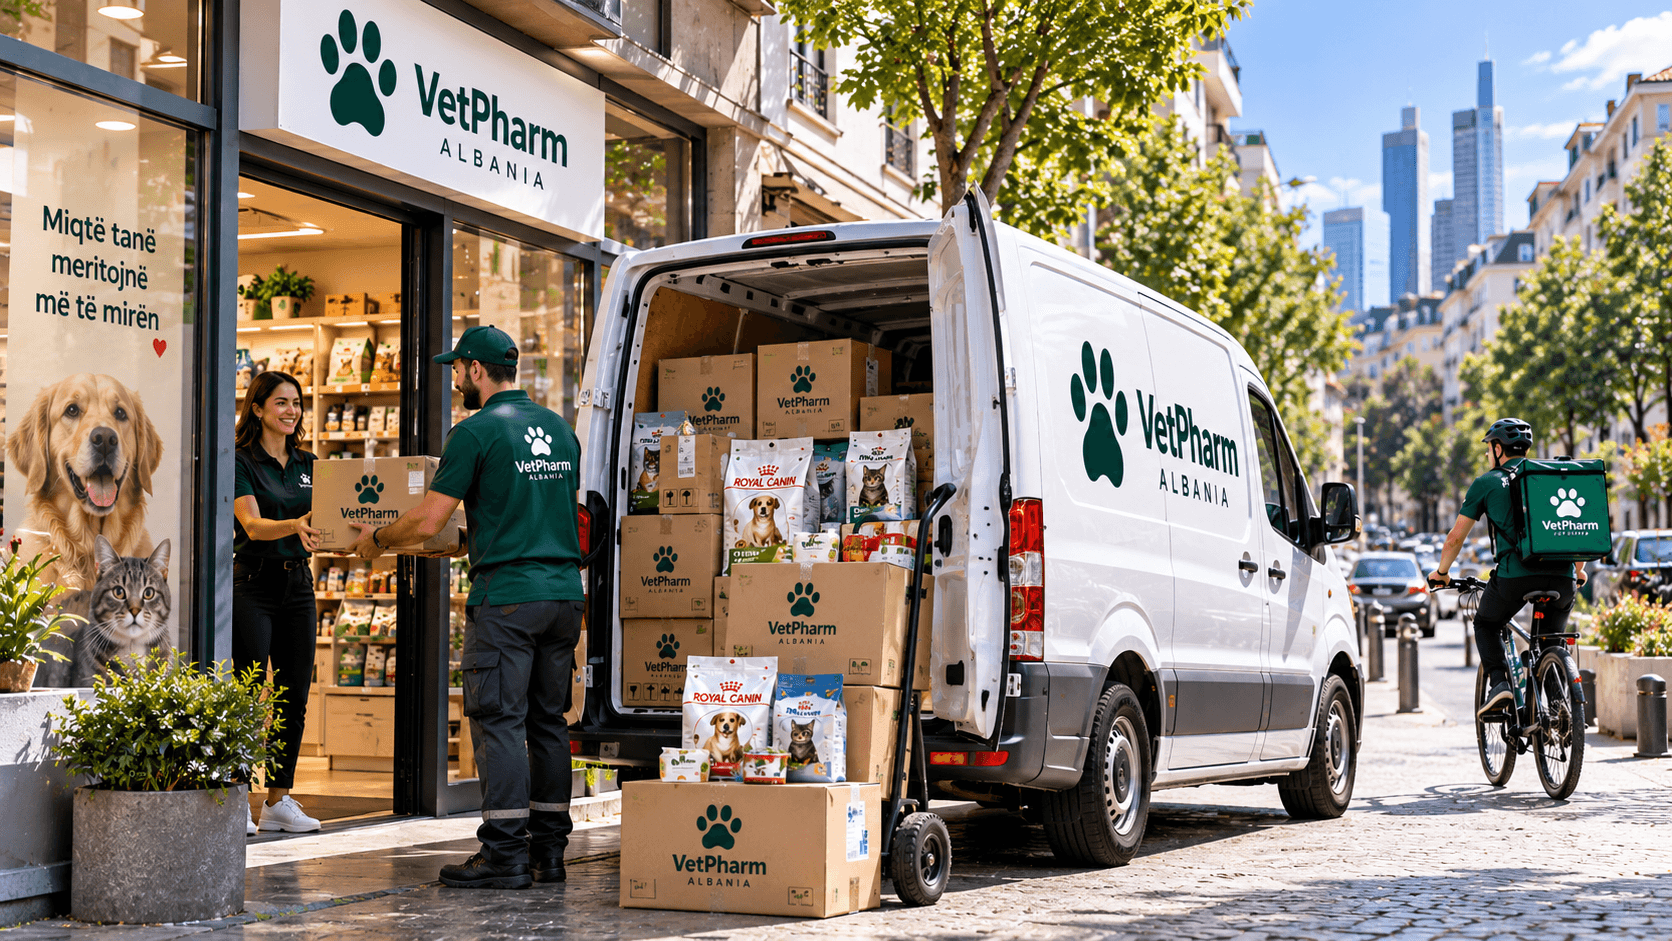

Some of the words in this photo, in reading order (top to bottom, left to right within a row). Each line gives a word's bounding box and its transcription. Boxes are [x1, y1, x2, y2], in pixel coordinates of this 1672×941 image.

[414, 62, 568, 168] VetPharm
[439, 138, 544, 190] ALBANIA
[42, 205, 106, 245] Miqtë
[111, 223, 157, 254] tanë
[51, 253, 149, 292] meritojnë
[35, 290, 70, 317] më
[75, 294, 97, 321] të
[103, 300, 160, 331] mirën
[776, 396, 830, 409] VetPharm
[688, 414, 740, 427] VetPharm
[1135, 389, 1240, 478] VetPharm
[514, 459, 572, 474] VetPharm
[733, 477, 764, 488] ROYAL
[766, 476, 797, 487] CANIN
[1159, 468, 1229, 508] ALBANIA
[340, 507, 399, 519] VetPharm
[1541, 519, 1599, 531] VetPharm
[640, 575, 691, 587] VetPharm
[767, 620, 837, 635] VetPharm
[693, 692, 727, 703] ROYAL
[729, 692, 763, 703] CANIN
[672, 854, 767, 875] VetPharm
[687, 876, 751, 889] ALBANIA
